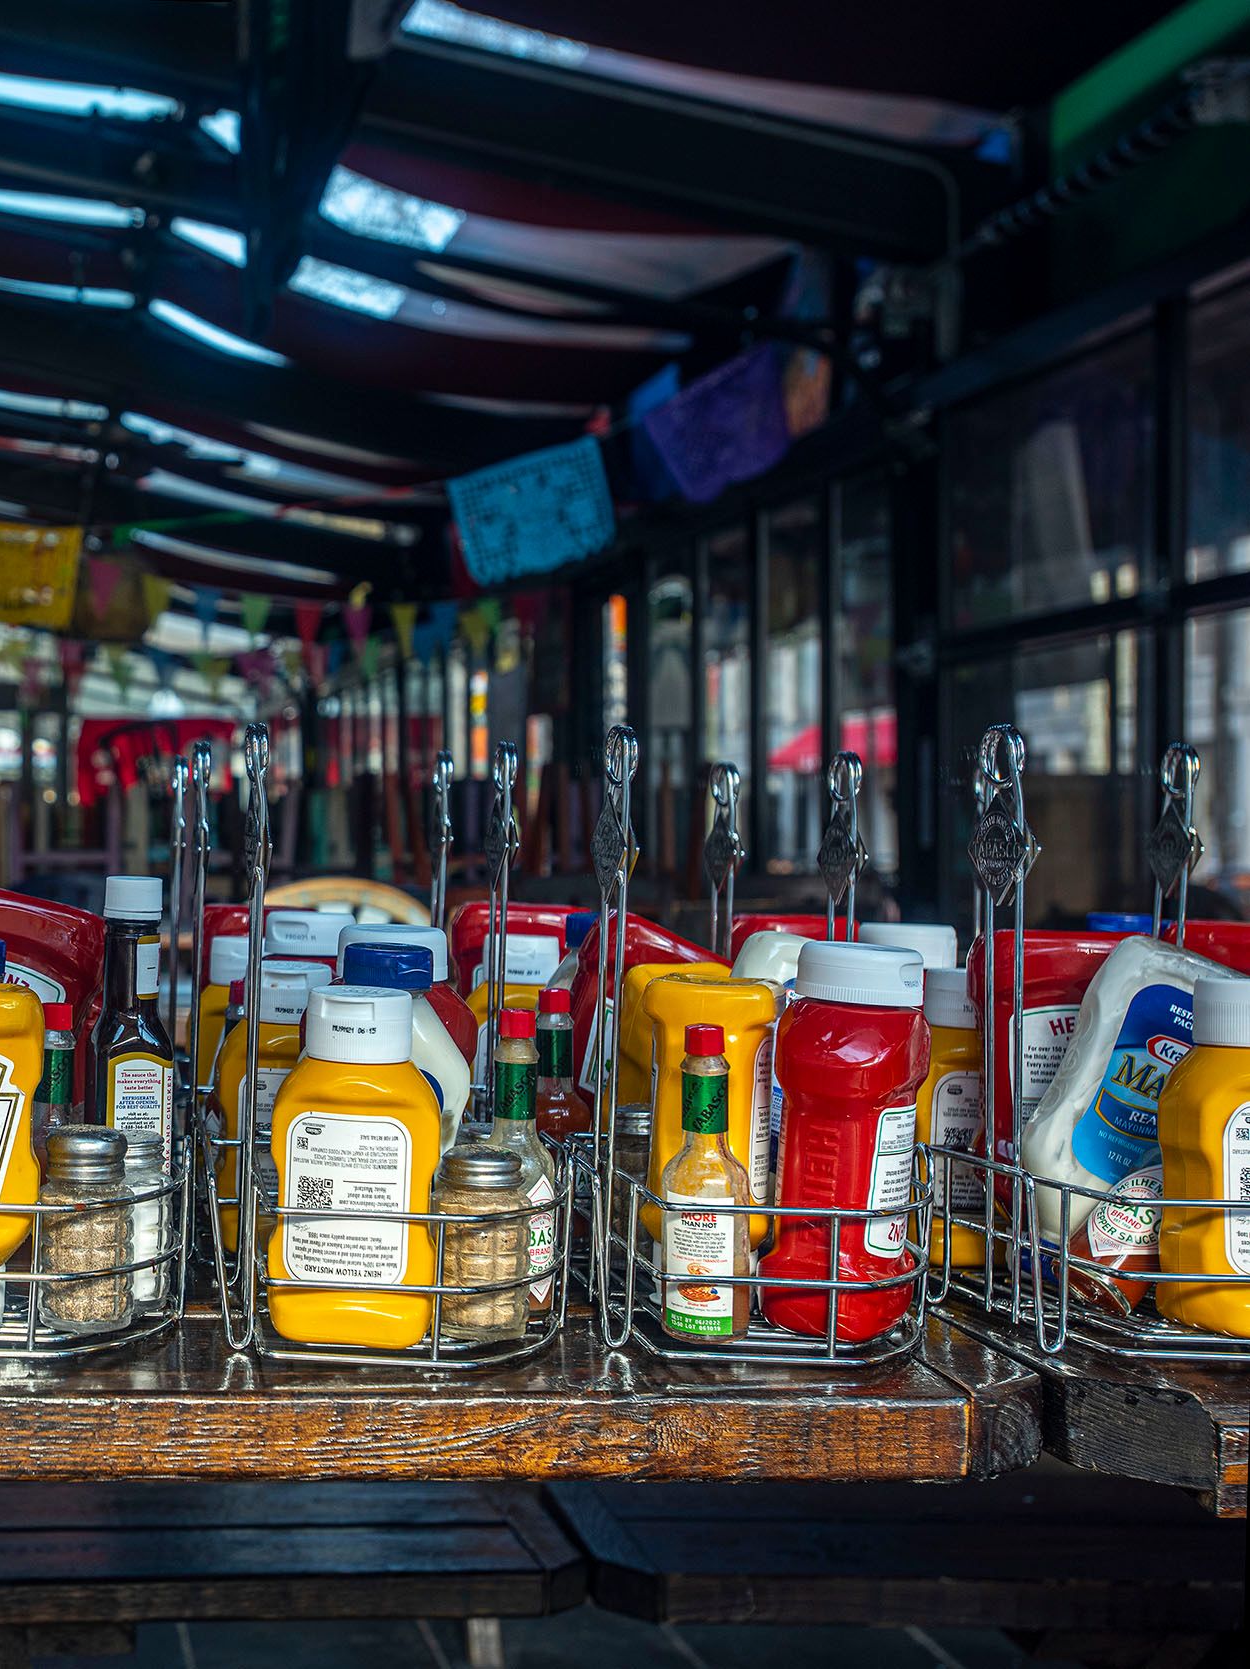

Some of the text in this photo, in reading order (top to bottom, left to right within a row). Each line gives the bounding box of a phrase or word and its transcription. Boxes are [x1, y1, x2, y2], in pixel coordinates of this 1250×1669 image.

[1108, 1151, 1115, 1160] 12
[1116, 1153, 1122, 1162] FL
[681, 1212, 717, 1222] MORE
[1110, 1209, 1142, 1230] BRAND
[682, 1220, 700, 1228] THAN
[1097, 1205, 1117, 1236] PEPPER
[1118, 1231, 1159, 1245] SAUCE
[304, 1254, 321, 1262] including
[304, 1264, 382, 1278] HEINZ YELLOW MUSTARD
